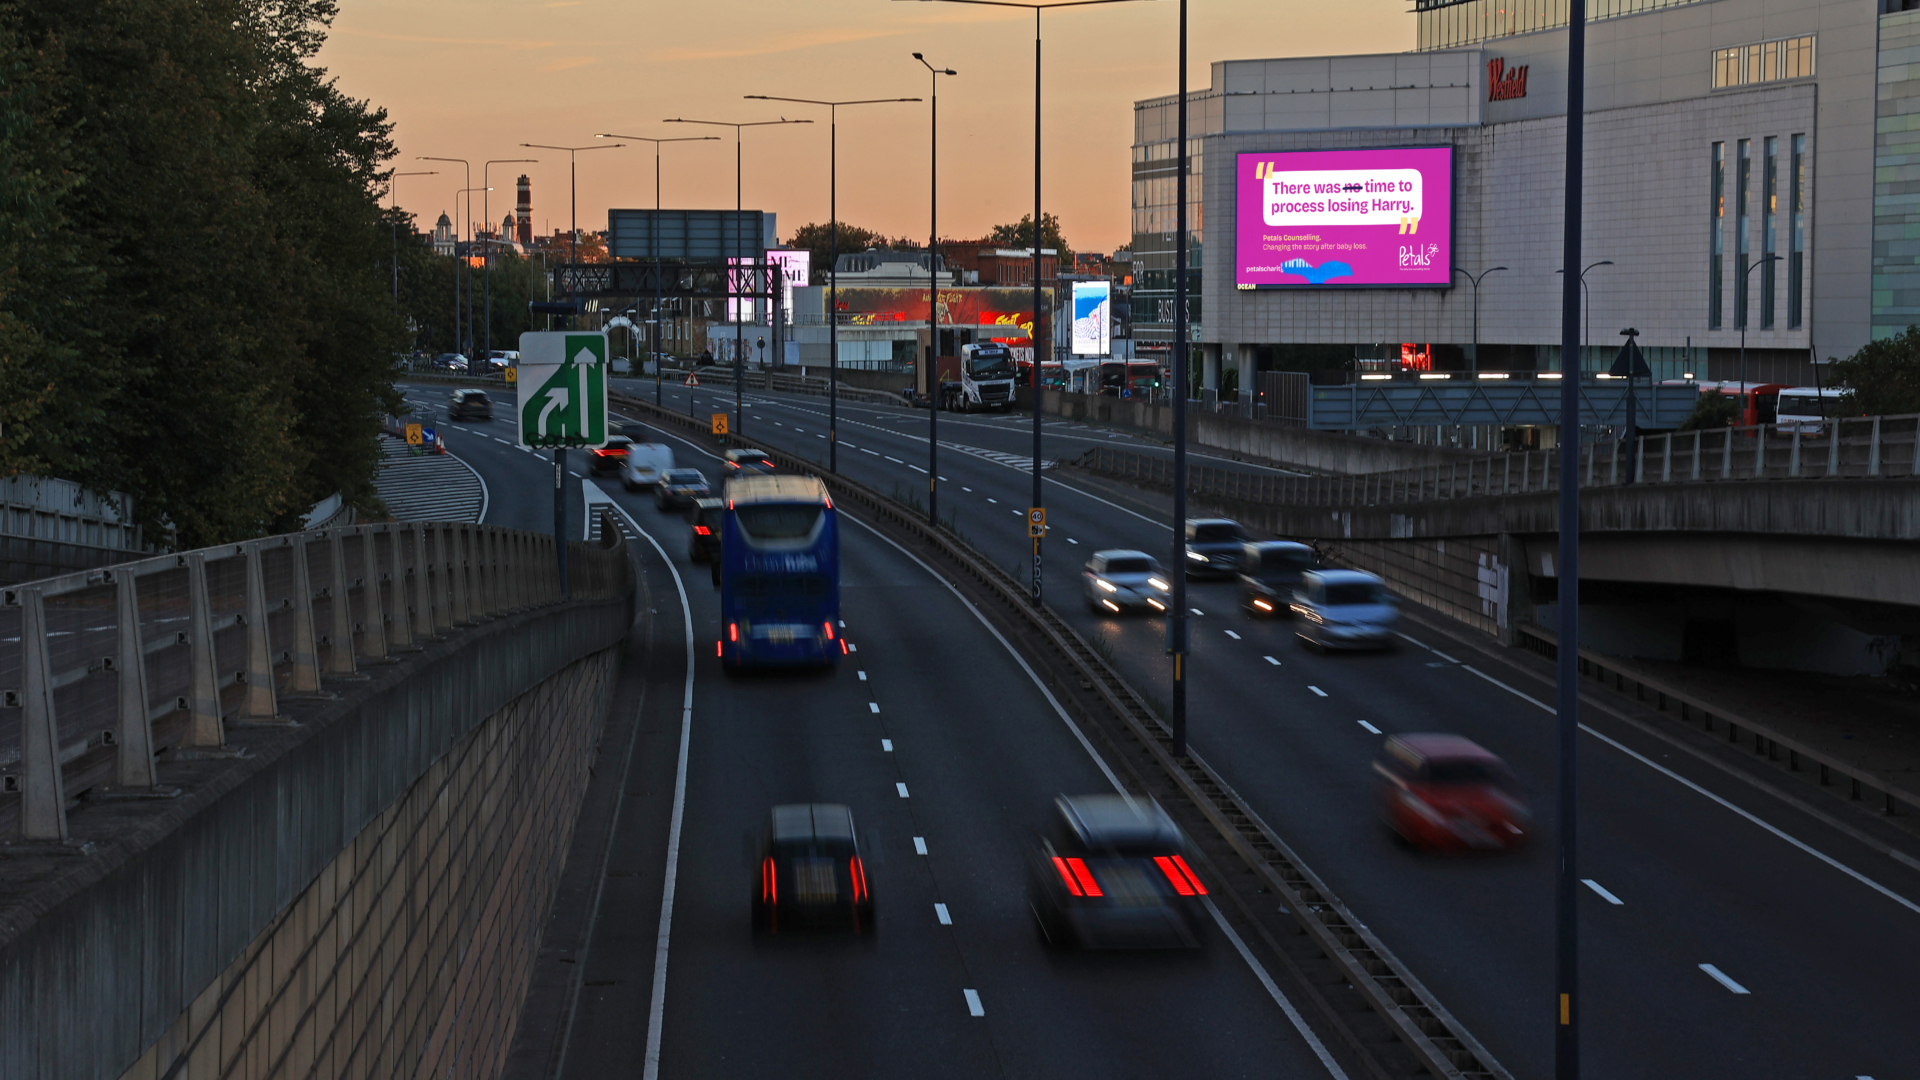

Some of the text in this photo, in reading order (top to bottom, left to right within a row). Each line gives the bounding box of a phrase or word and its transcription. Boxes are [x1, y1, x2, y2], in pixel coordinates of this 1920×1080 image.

[1487, 57, 1528, 102] Westfield
[1272, 181, 1311, 195] There
[1313, 183, 1341, 194] was
[1364, 179, 1395, 193] time
[1398, 179, 1413, 192] to
[1271, 198, 1414, 216] process losing Harry.
[1263, 234, 1322, 242] Petals Counselling.
[1263, 243, 1291, 251] Changing
[1303, 243, 1320, 251] story
[1337, 243, 1353, 251] baby
[1353, 242, 1368, 250] loss.
[1399, 244, 1431, 267] Petals
[1132, 260, 1144, 284] FOR
[1157, 299, 1190, 323] BUSIS
